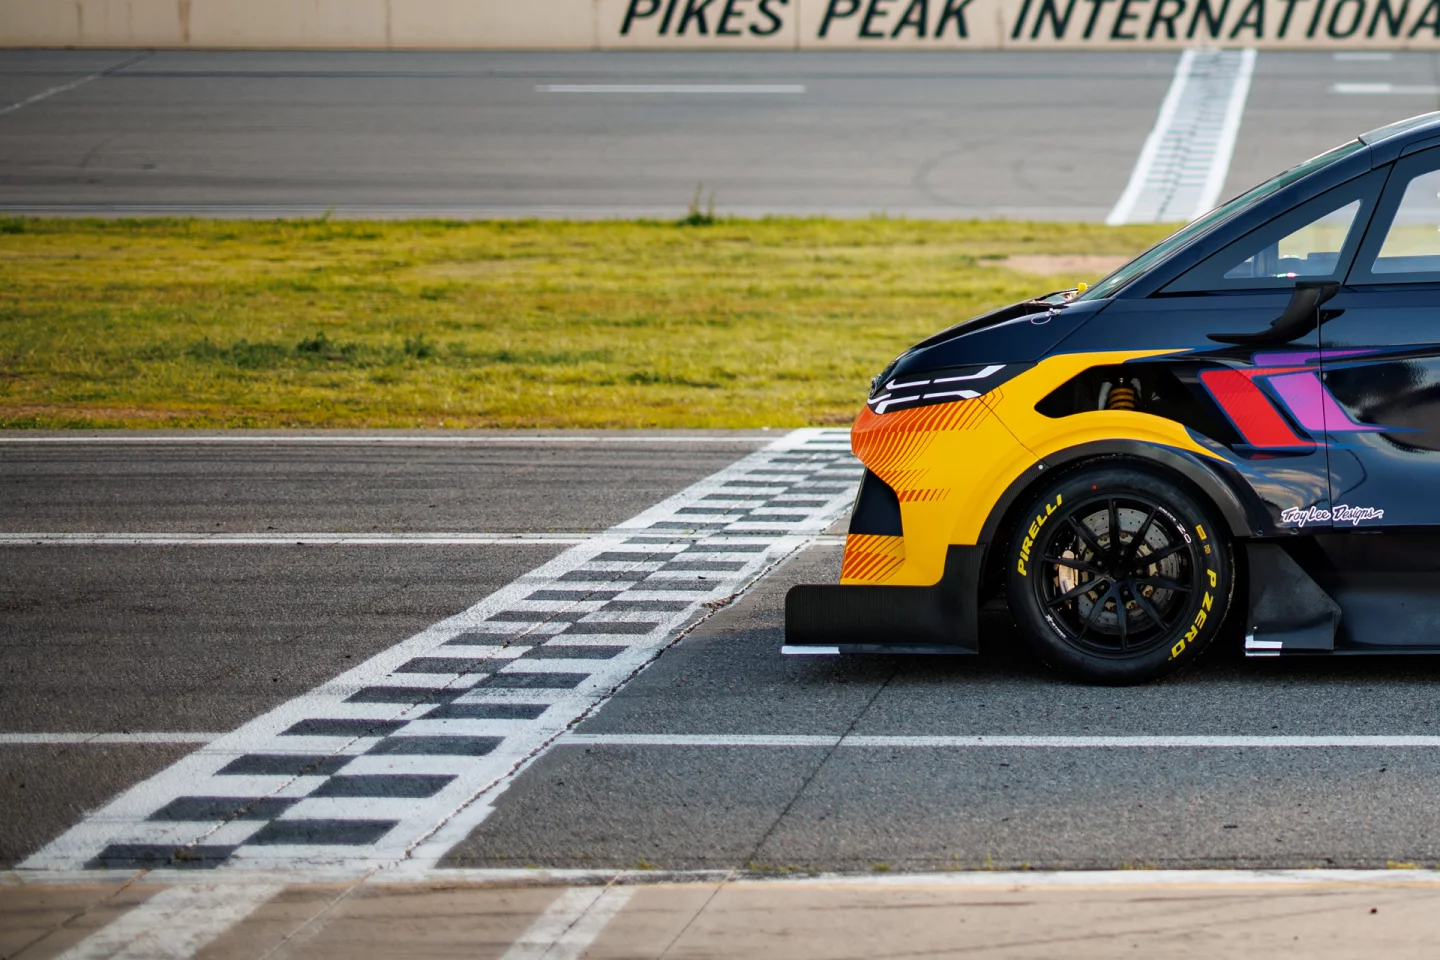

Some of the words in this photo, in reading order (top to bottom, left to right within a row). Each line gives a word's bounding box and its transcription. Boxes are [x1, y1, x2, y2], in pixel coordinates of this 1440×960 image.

[1017, 493, 1063, 576] PIRELLI
[1281, 506, 1308, 527] Troy
[1307, 506, 1331, 522] Lee
[1332, 504, 1384, 525] Designs
[1206, 568, 1217, 588] P
[1171, 591, 1214, 658] ZERO
